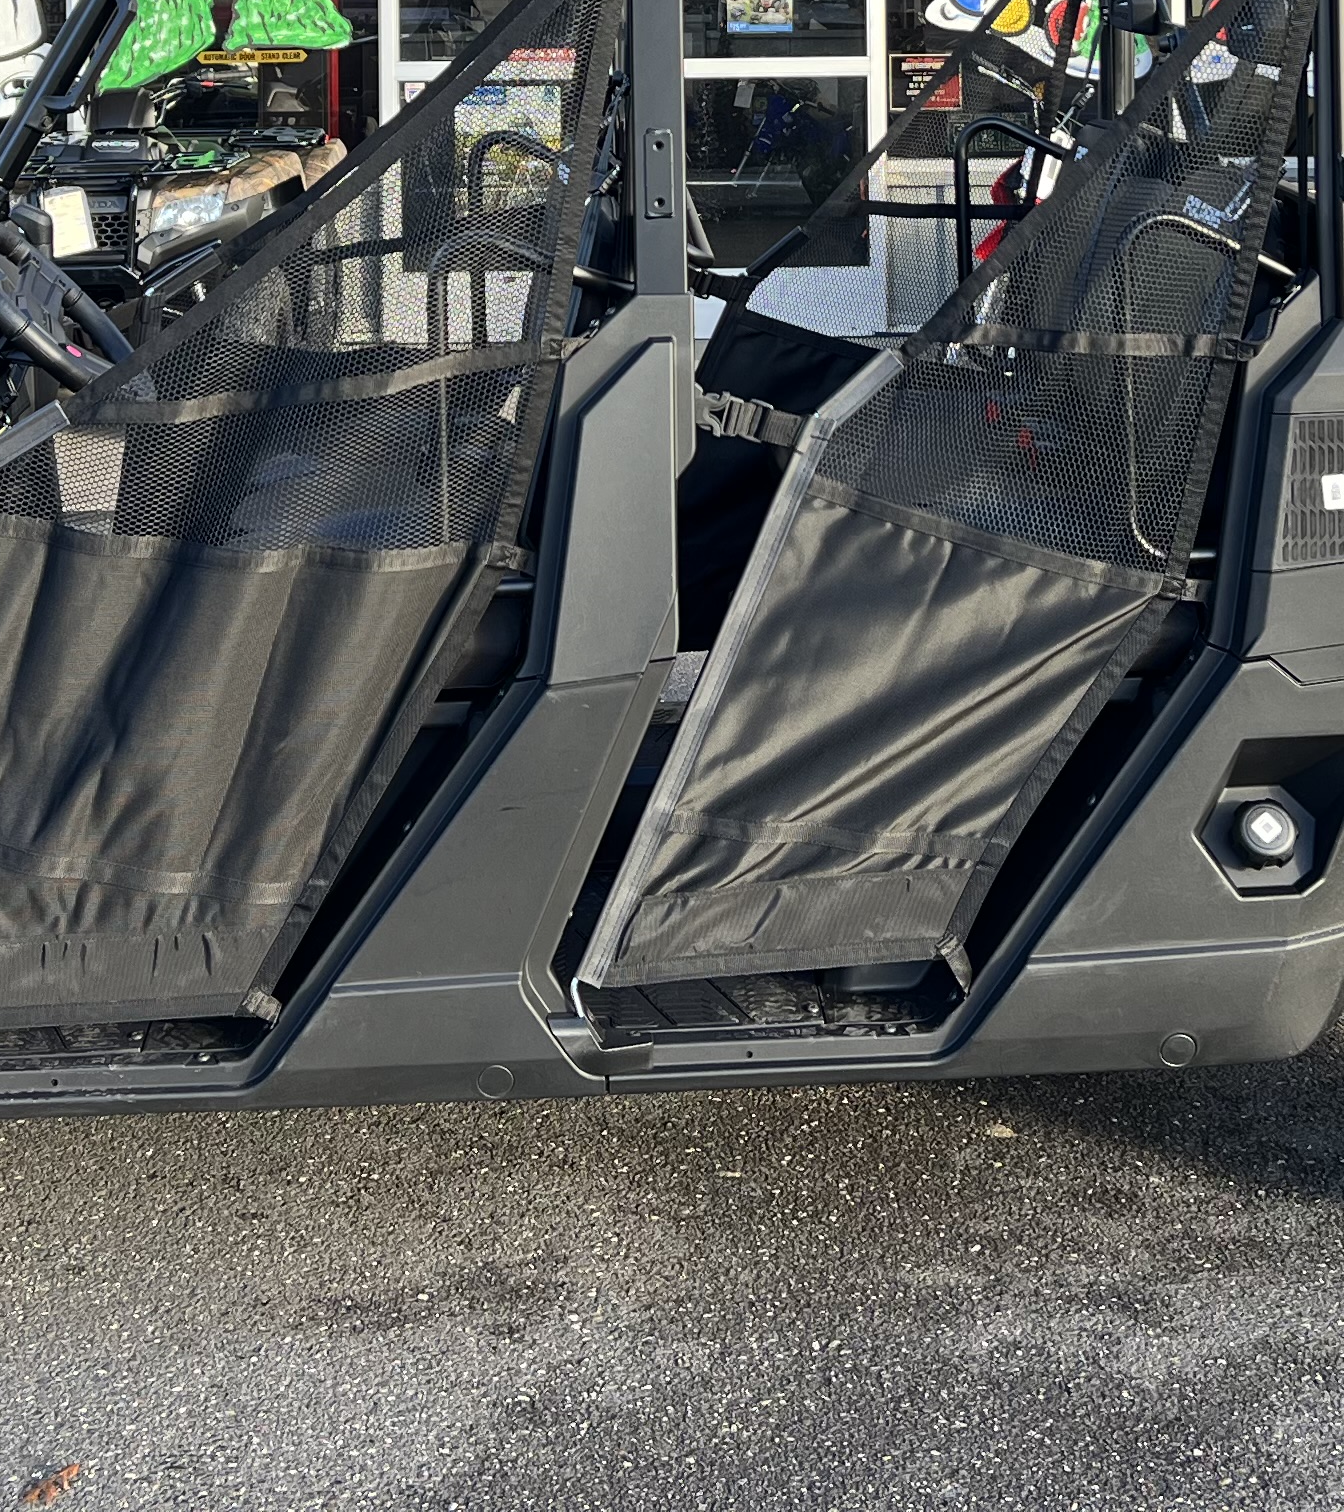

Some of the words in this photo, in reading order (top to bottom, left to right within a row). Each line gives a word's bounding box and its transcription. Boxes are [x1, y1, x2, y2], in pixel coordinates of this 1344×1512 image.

[239, 52, 256, 61] DOOR
[260, 52, 280, 60] STAND
[281, 51, 301, 60] CLEAR
